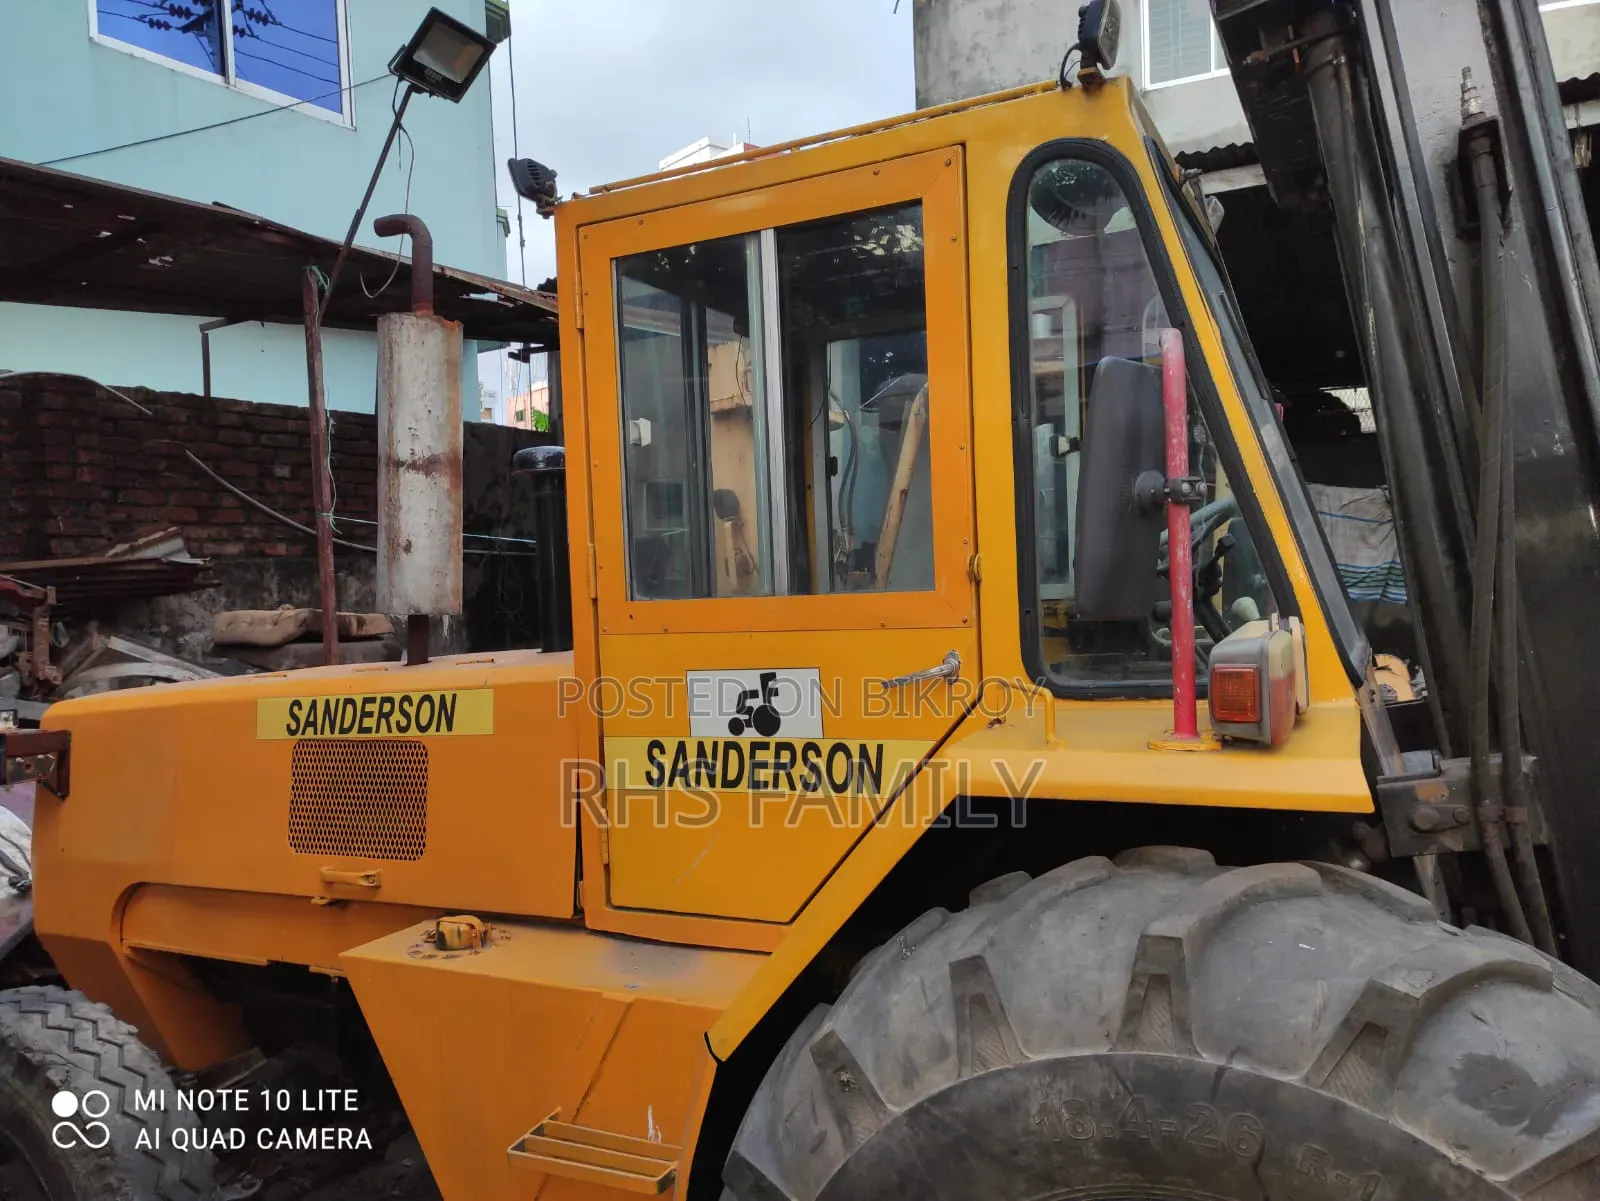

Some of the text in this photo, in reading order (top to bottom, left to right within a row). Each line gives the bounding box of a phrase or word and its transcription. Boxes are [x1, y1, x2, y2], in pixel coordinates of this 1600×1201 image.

[286, 693, 457, 736] SANDERSON
[645, 739, 881, 795] SANDERSON
[1033, 1094, 1267, 1157] 18.4-26
